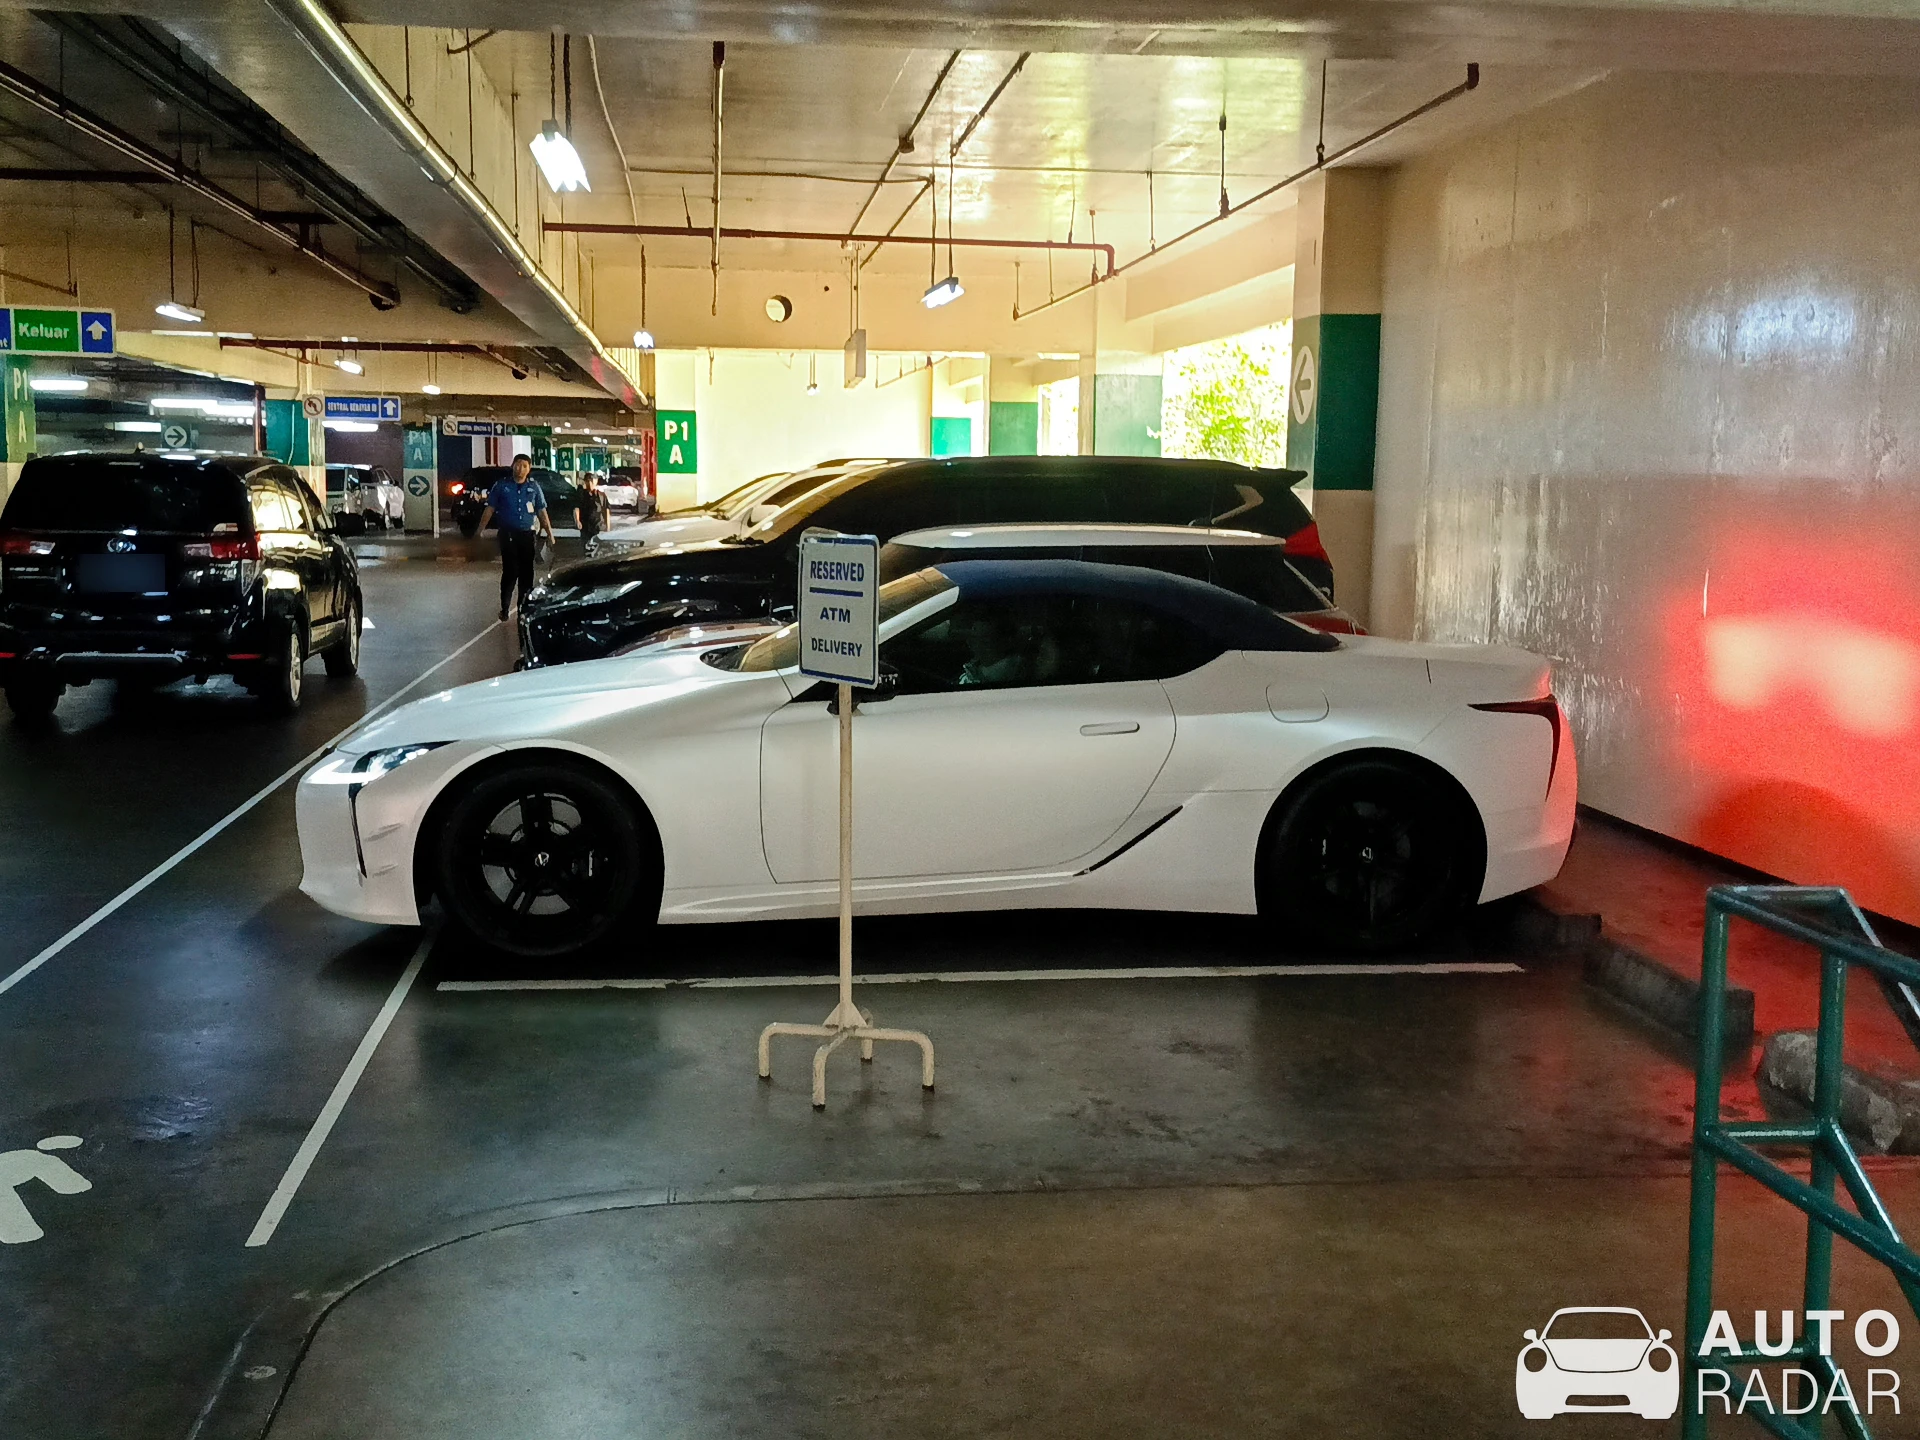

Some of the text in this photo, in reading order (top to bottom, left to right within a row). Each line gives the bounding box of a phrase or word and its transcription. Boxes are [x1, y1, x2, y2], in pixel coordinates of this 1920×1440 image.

[18, 322, 70, 339] Keluar
[13, 367, 28, 401] P1
[18, 410, 27, 443] A
[664, 420, 688, 441] P1
[408, 430, 427, 445] P1
[413, 447, 423, 461] A
[669, 444, 683, 464] A
[810, 560, 864, 582] RESERVED
[820, 607, 851, 624] ATM
[811, 637, 862, 657] DELIVERY
